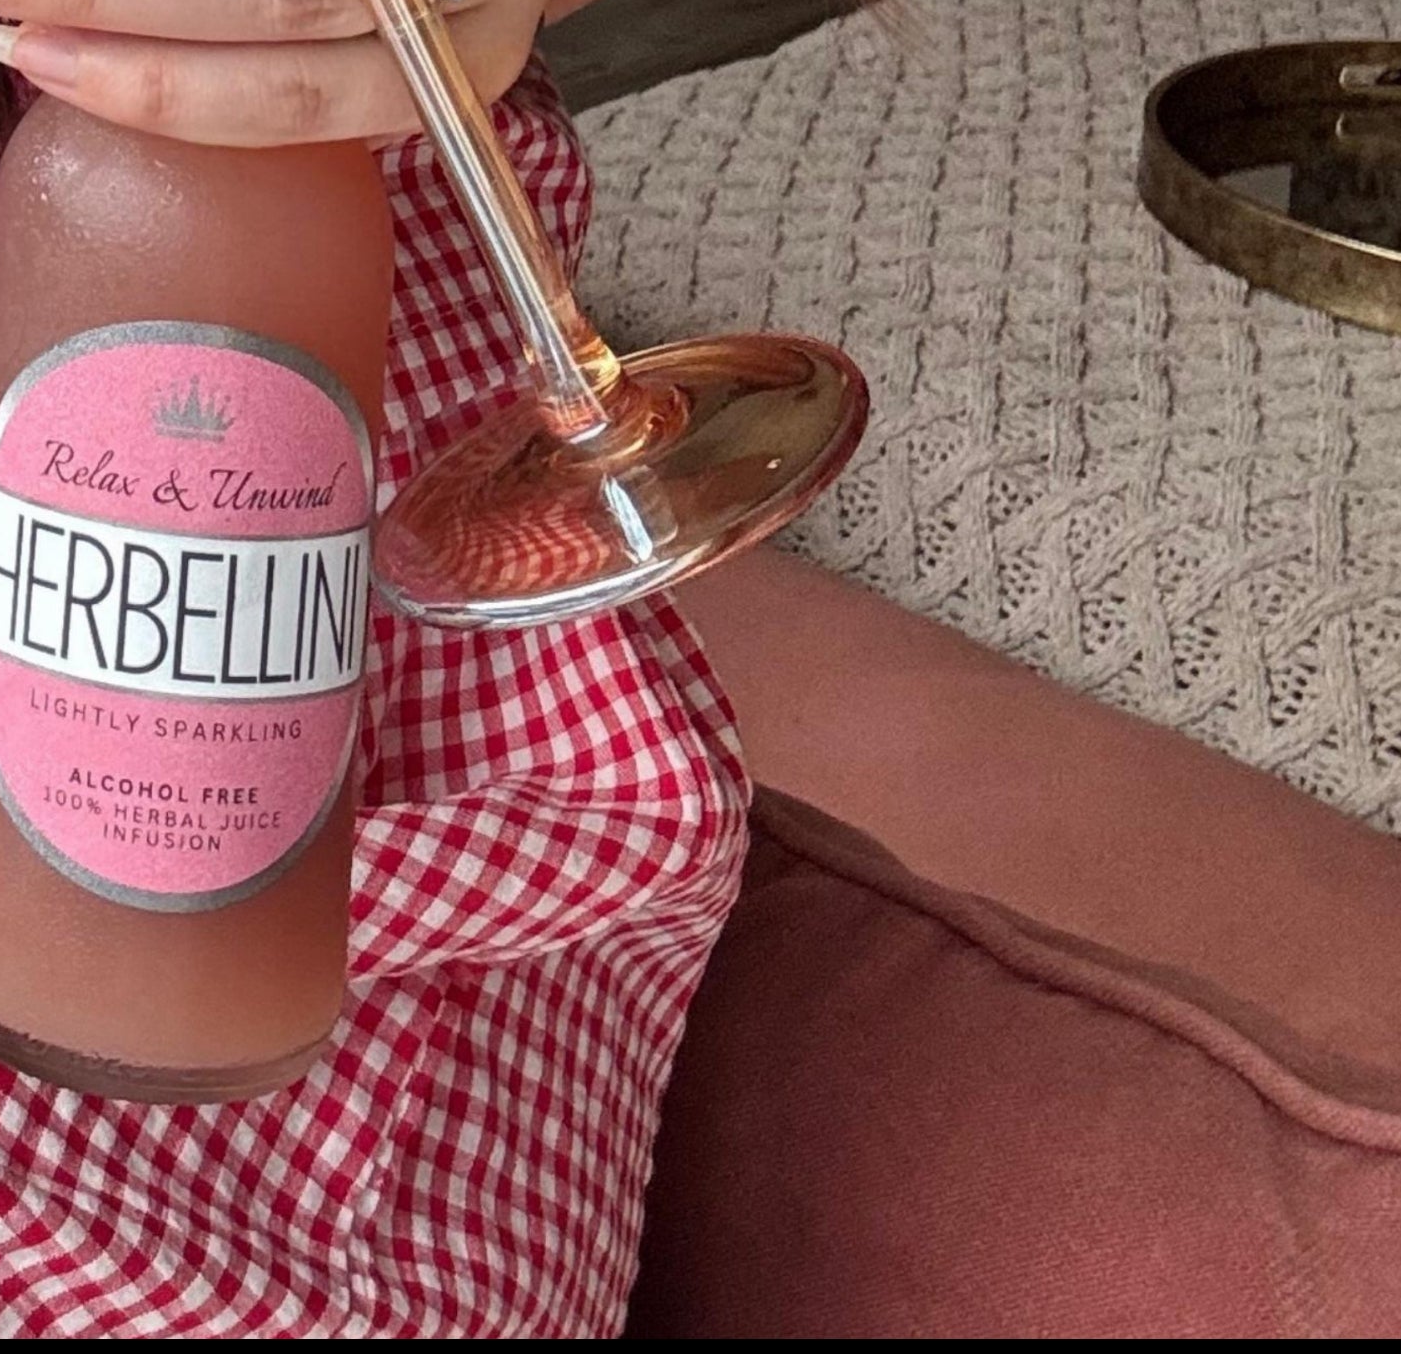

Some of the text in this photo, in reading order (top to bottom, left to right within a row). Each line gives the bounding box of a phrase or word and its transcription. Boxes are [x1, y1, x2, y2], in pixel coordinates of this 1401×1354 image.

[41, 439, 348, 511] Relax & Unwind
[29, 688, 303, 741] LIGHTLY SPARKLING
[67, 767, 259, 806] ALCOHOL FREE
[43, 787, 283, 832] 100% HERBAL JUICE
[102, 823, 223, 853] INFUSION
